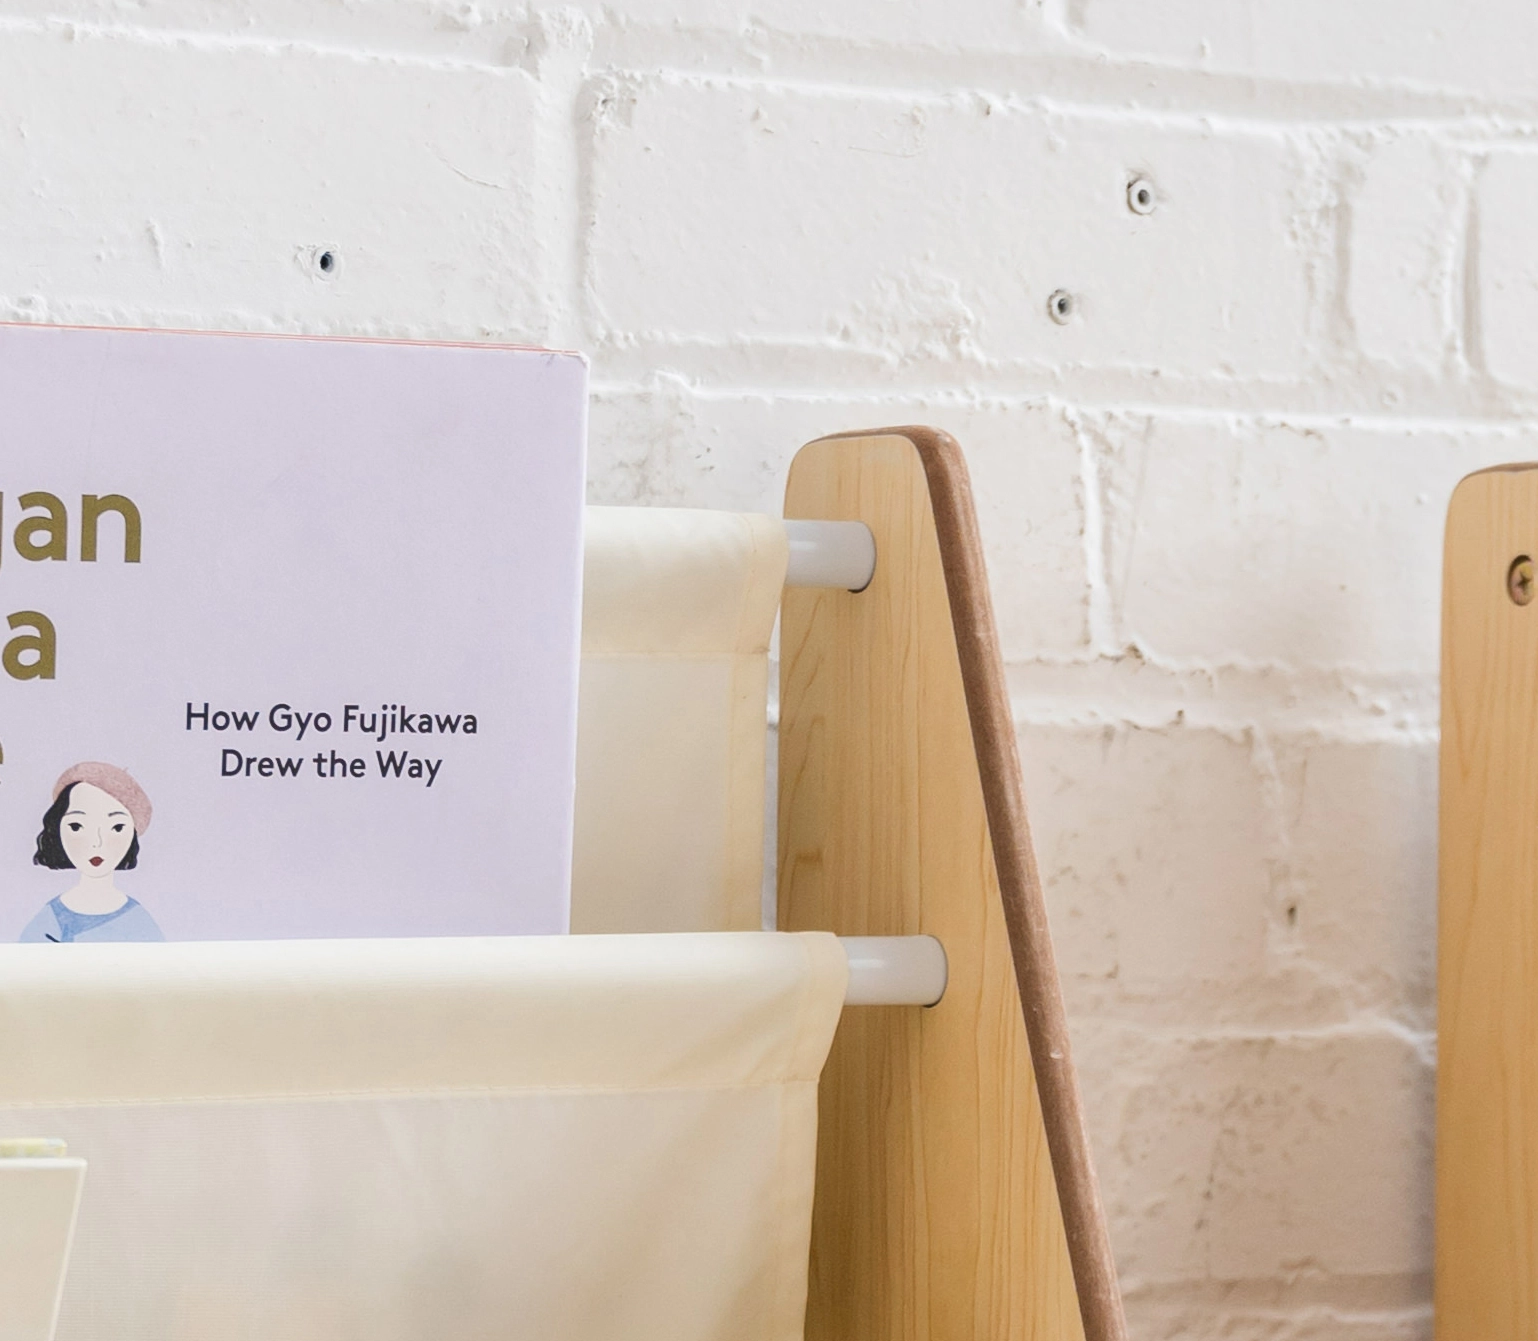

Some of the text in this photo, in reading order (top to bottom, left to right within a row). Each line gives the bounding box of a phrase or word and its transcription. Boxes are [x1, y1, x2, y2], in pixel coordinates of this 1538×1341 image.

[0, 491, 142, 568] an
[185, 702, 478, 742] How Gyo Fujikawa
[220, 749, 442, 787] Drew the Way
